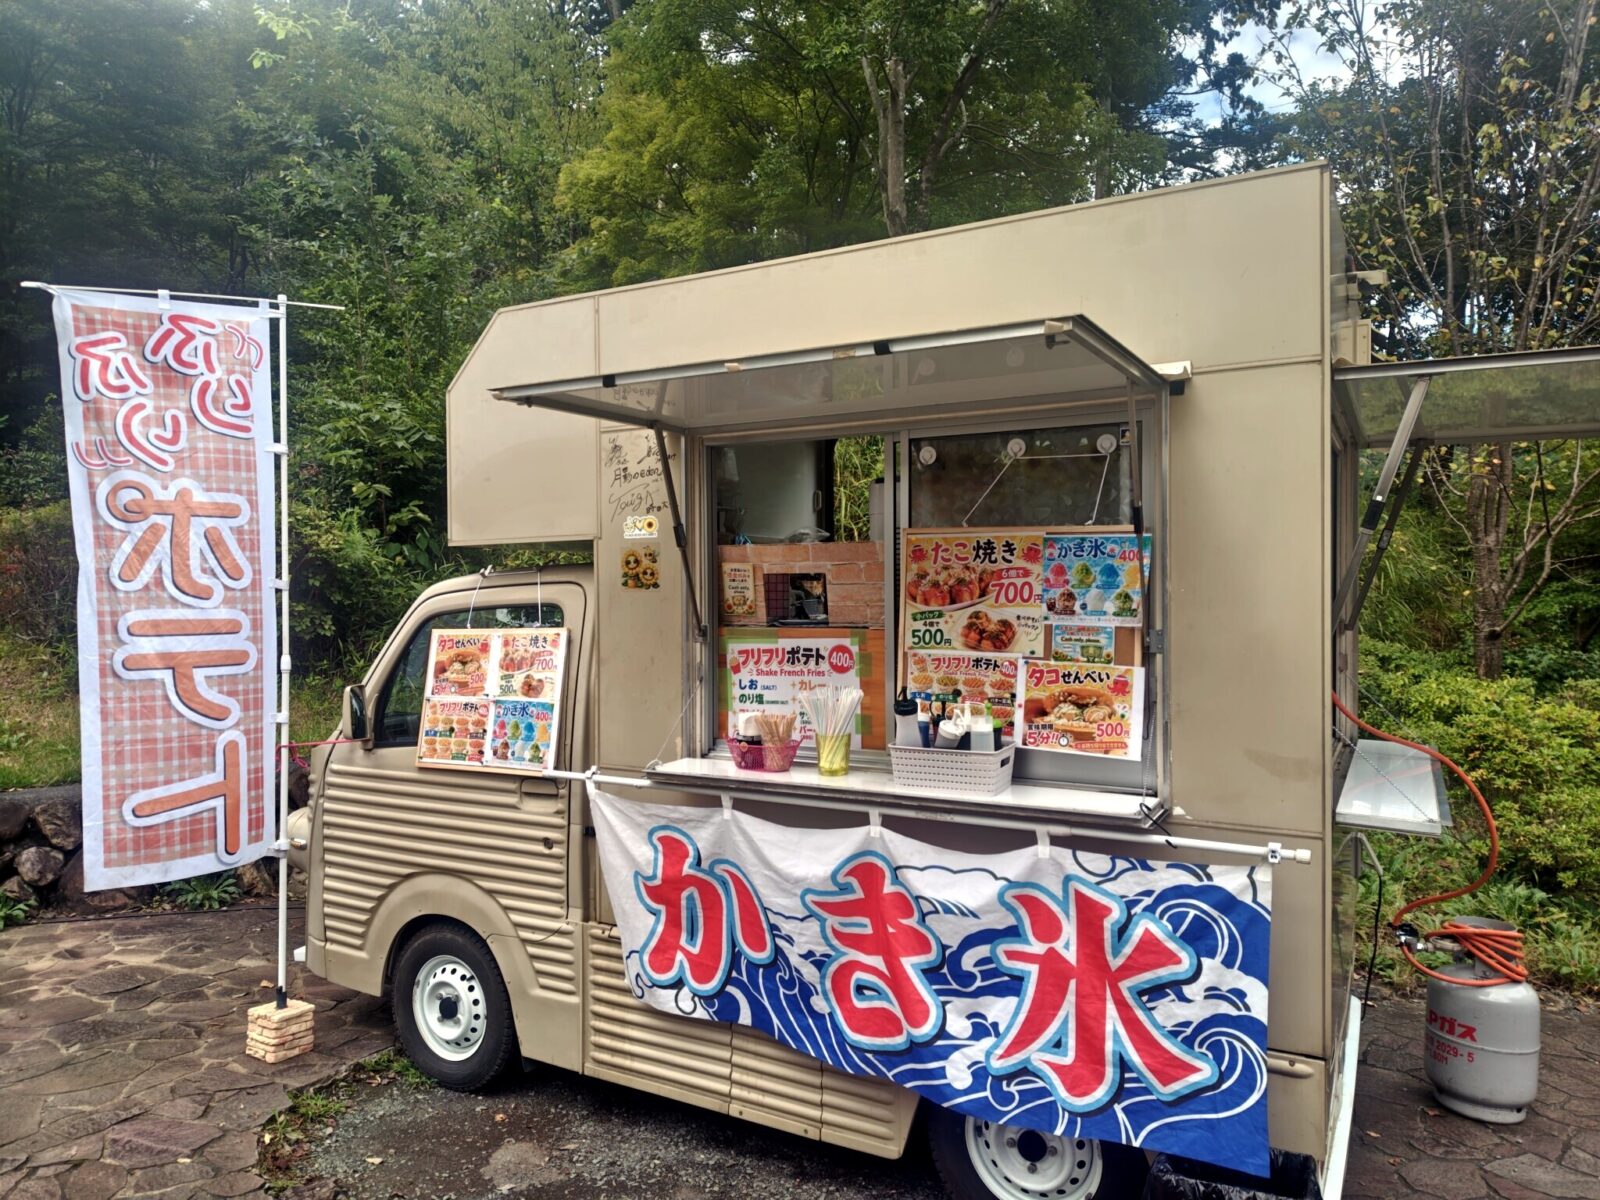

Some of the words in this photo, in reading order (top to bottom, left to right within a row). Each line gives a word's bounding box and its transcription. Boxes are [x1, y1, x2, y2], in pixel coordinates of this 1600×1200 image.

[931, 538, 1017, 565] たこ焼き
[1057, 538, 1107, 559] かき氷
[991, 581, 1043, 605] 700円
[439, 638, 480, 652] タコせんべい
[511, 634, 549, 649] たこ焼き
[911, 628, 952, 647] 500円
[737, 645, 826, 667] フリフリポテト
[830, 651, 856, 670] 400円
[931, 656, 1001, 672] フリフリポテト
[756, 668, 779, 677] Shake
[780, 668, 806, 677] French
[807, 668, 826, 677] Fries
[1028, 668, 1111, 688] タコせんべい
[738, 679, 758, 690] しお
[799, 679, 827, 691] カレー
[440, 701, 479, 713] フリフリポテト
[738, 693, 765, 705] のり塩
[502, 702, 529, 718] かき氷
[1096, 722, 1130, 738] 500円
